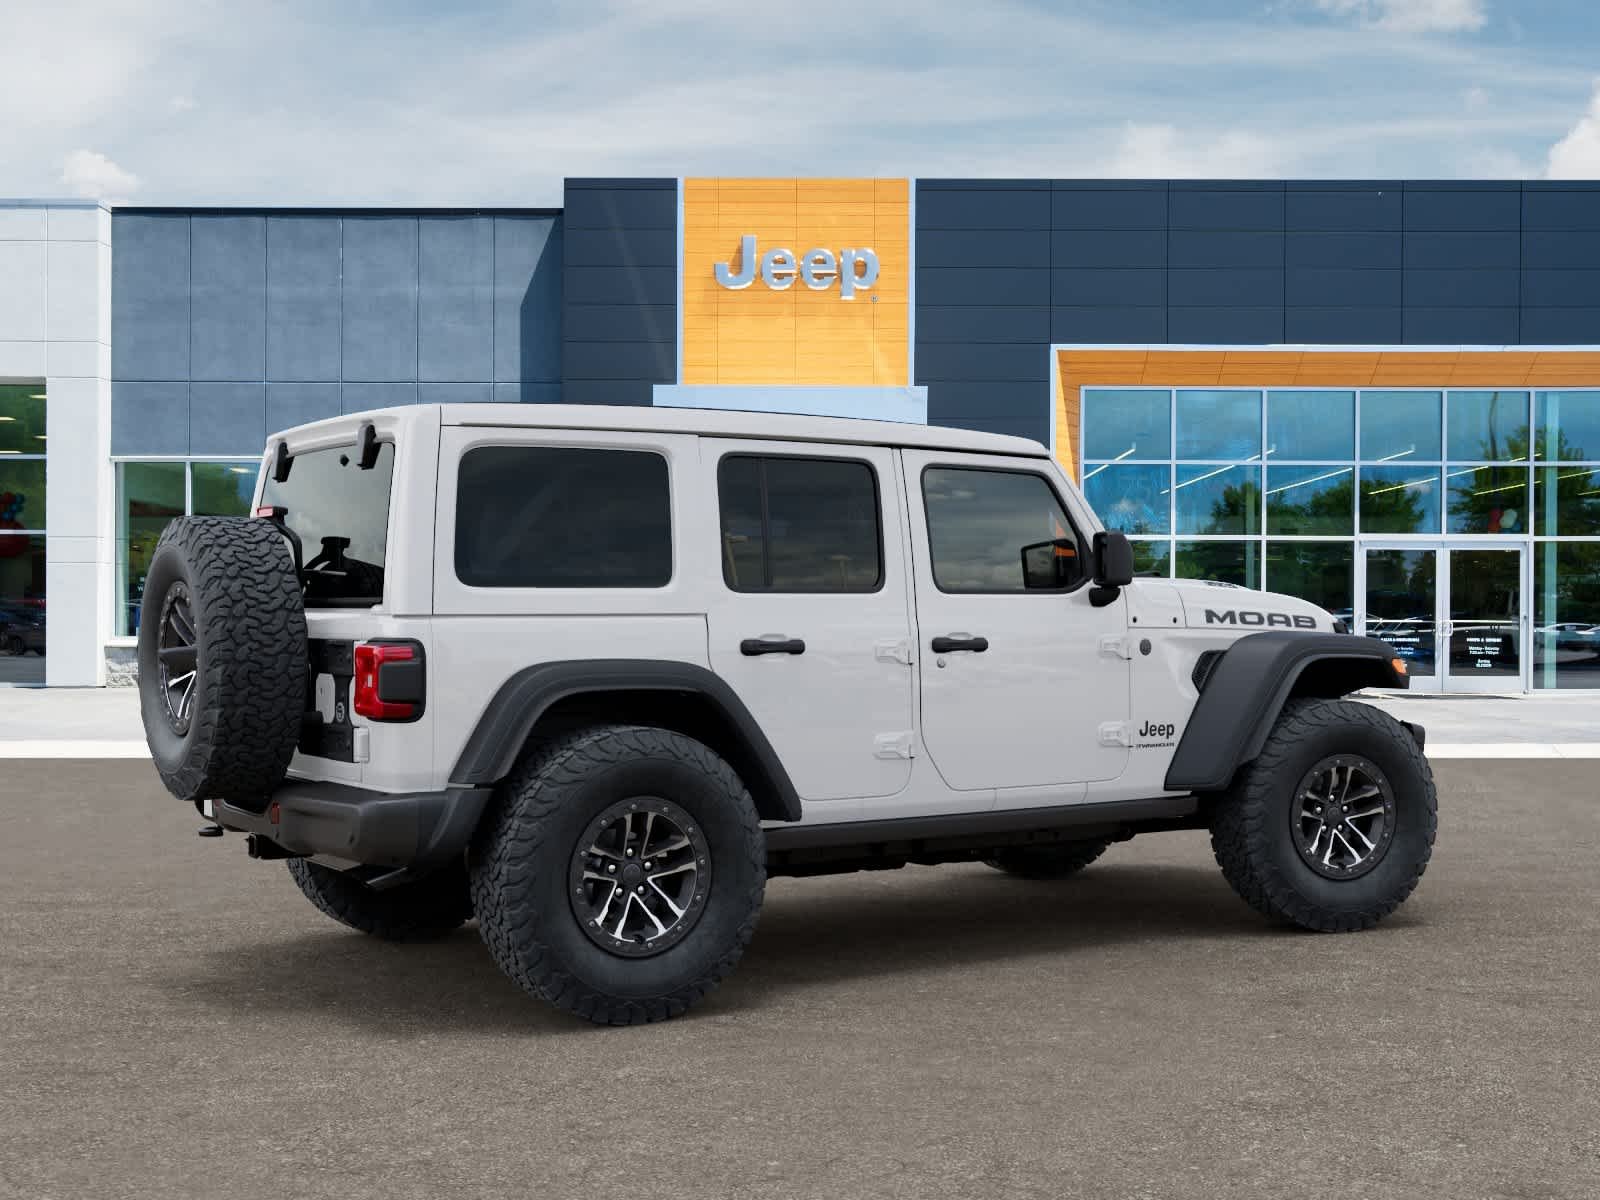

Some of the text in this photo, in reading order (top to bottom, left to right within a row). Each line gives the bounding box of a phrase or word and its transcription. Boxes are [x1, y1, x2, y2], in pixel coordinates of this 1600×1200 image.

[713, 234, 880, 300] Jeep
[1205, 609, 1317, 629] MOAB
[1139, 720, 1174, 739] Jeep
